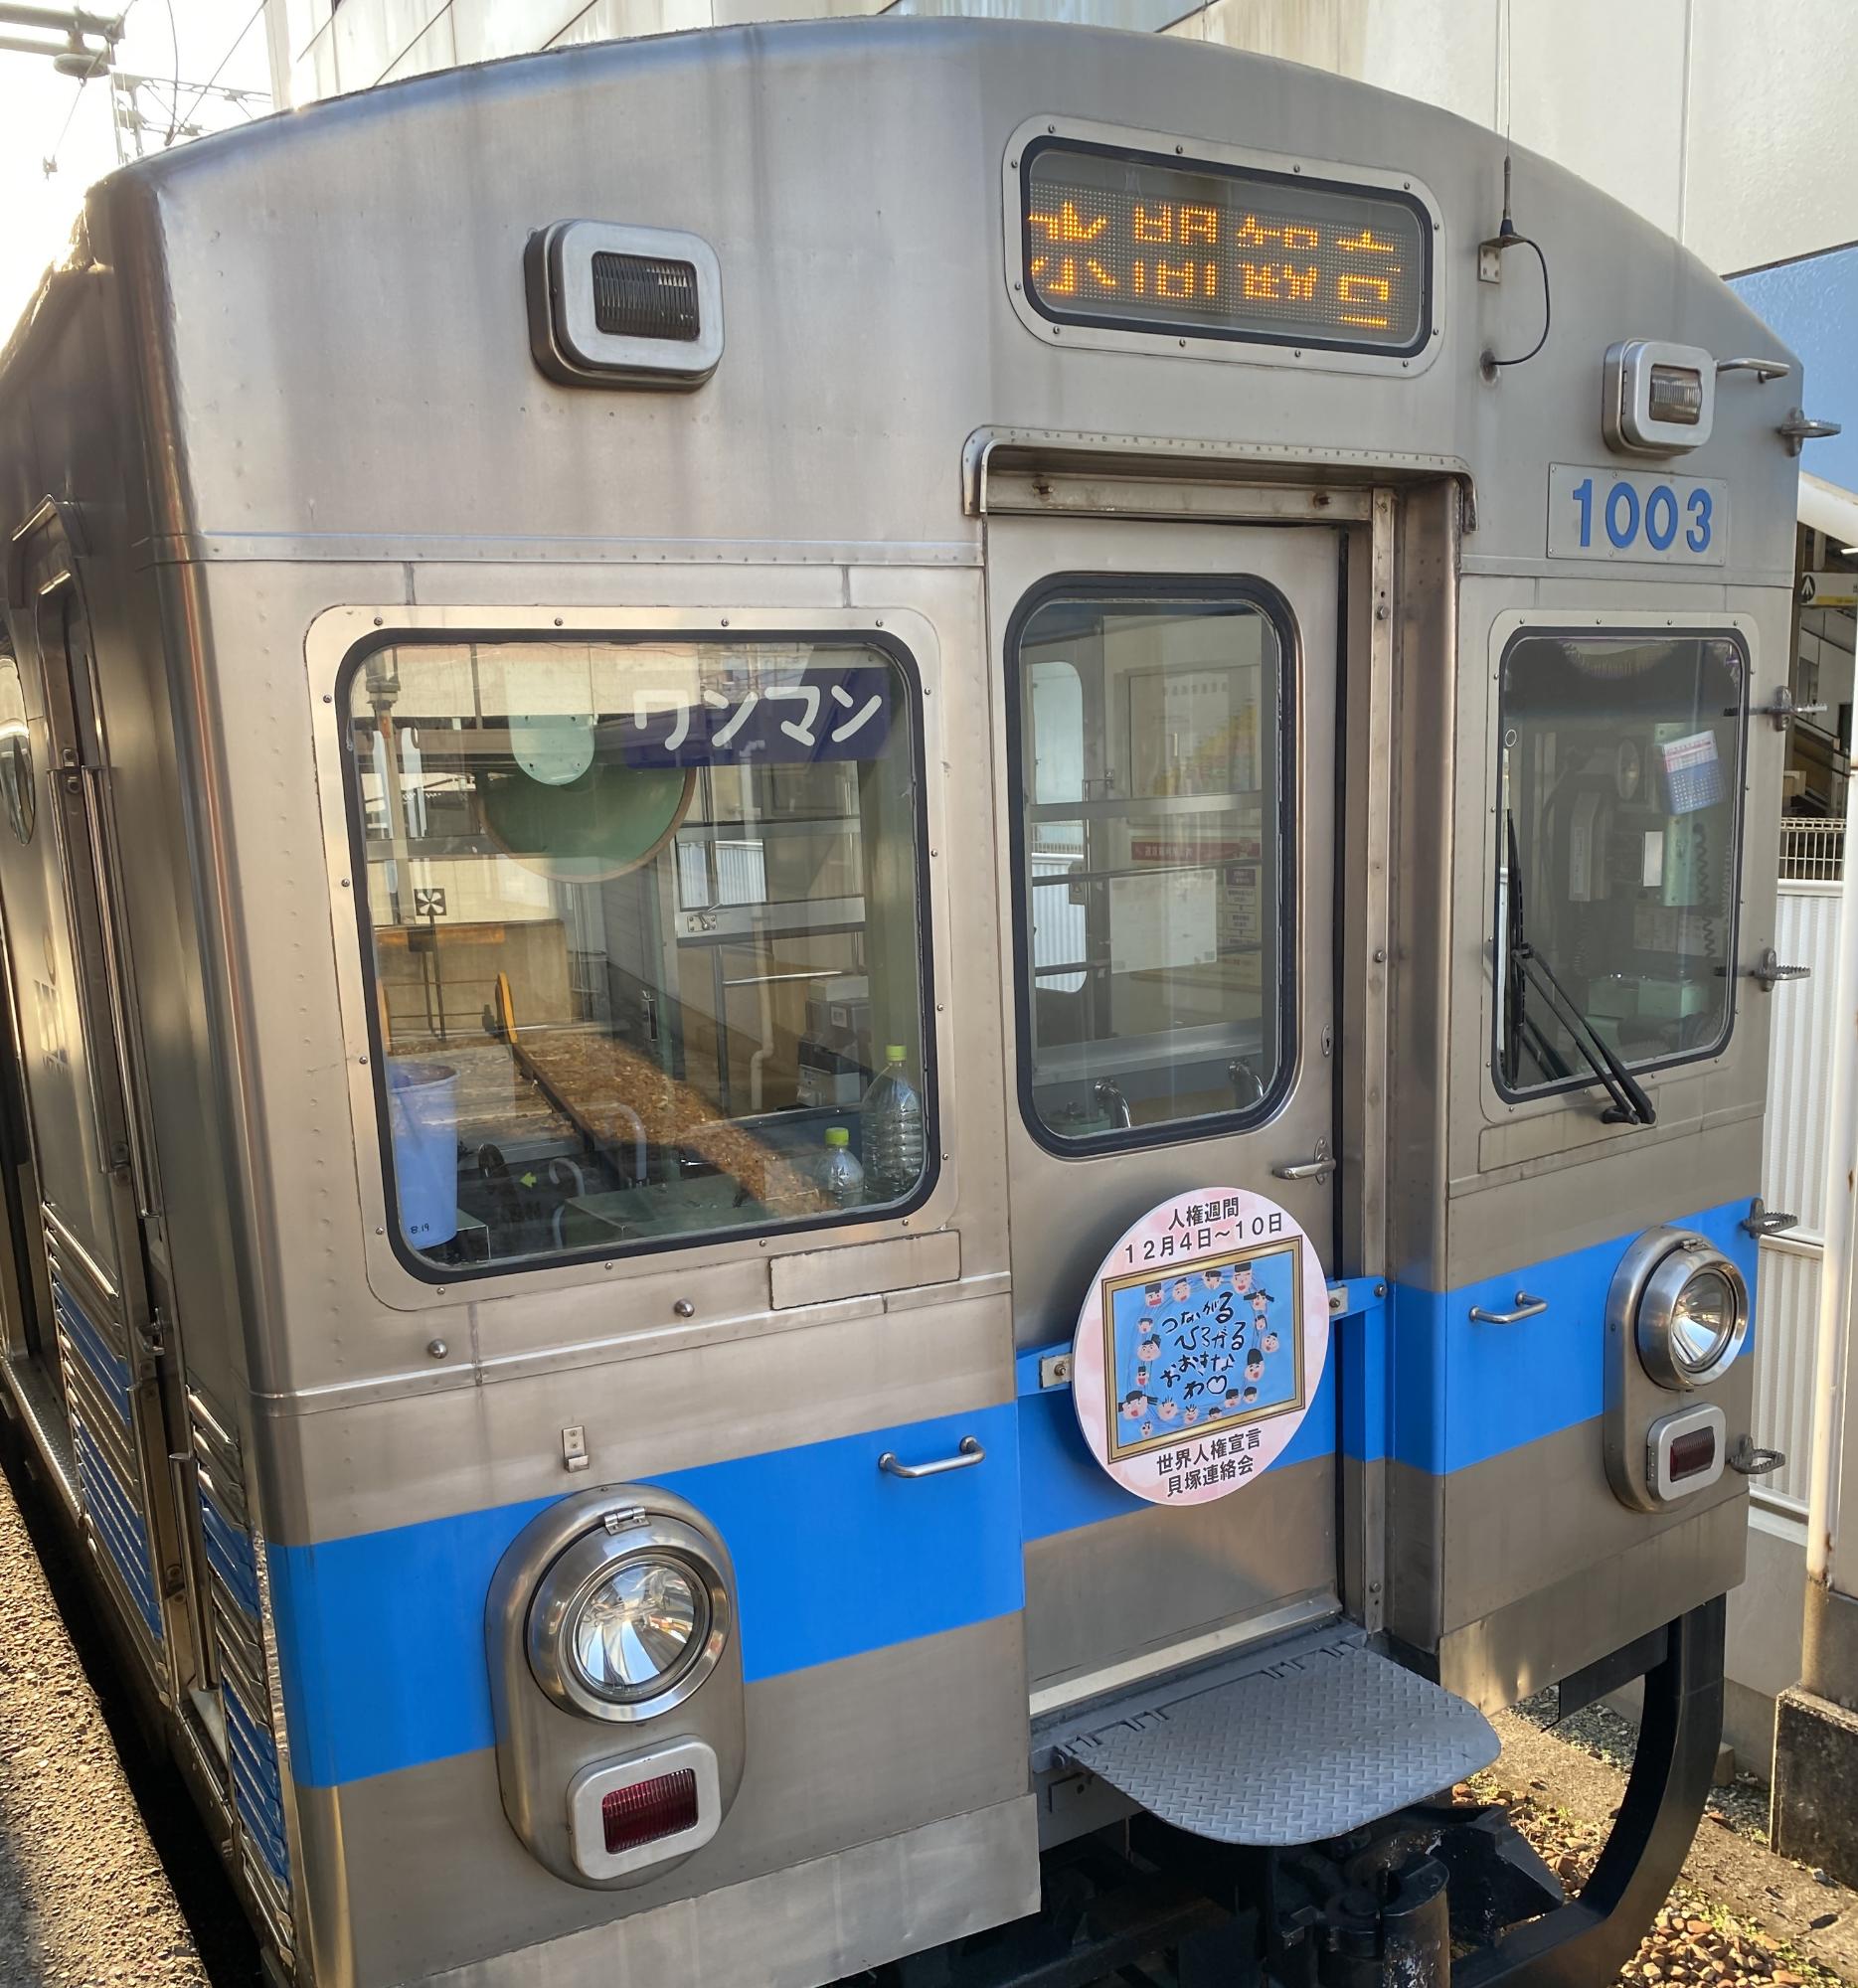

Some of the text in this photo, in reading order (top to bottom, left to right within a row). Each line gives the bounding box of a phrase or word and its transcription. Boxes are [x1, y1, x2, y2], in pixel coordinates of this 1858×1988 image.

[1574, 479, 1712, 553] 1003
[633, 685, 883, 750] ワンマン
[1168, 1197, 1240, 1231] 人権週間
[1162, 1291, 1234, 1334] つながる
[1174, 1322, 1247, 1351] ひろがる
[1156, 1427, 1262, 1476] 世界人権宣言
[1167, 1454, 1254, 1497] 貝塚連絡会
